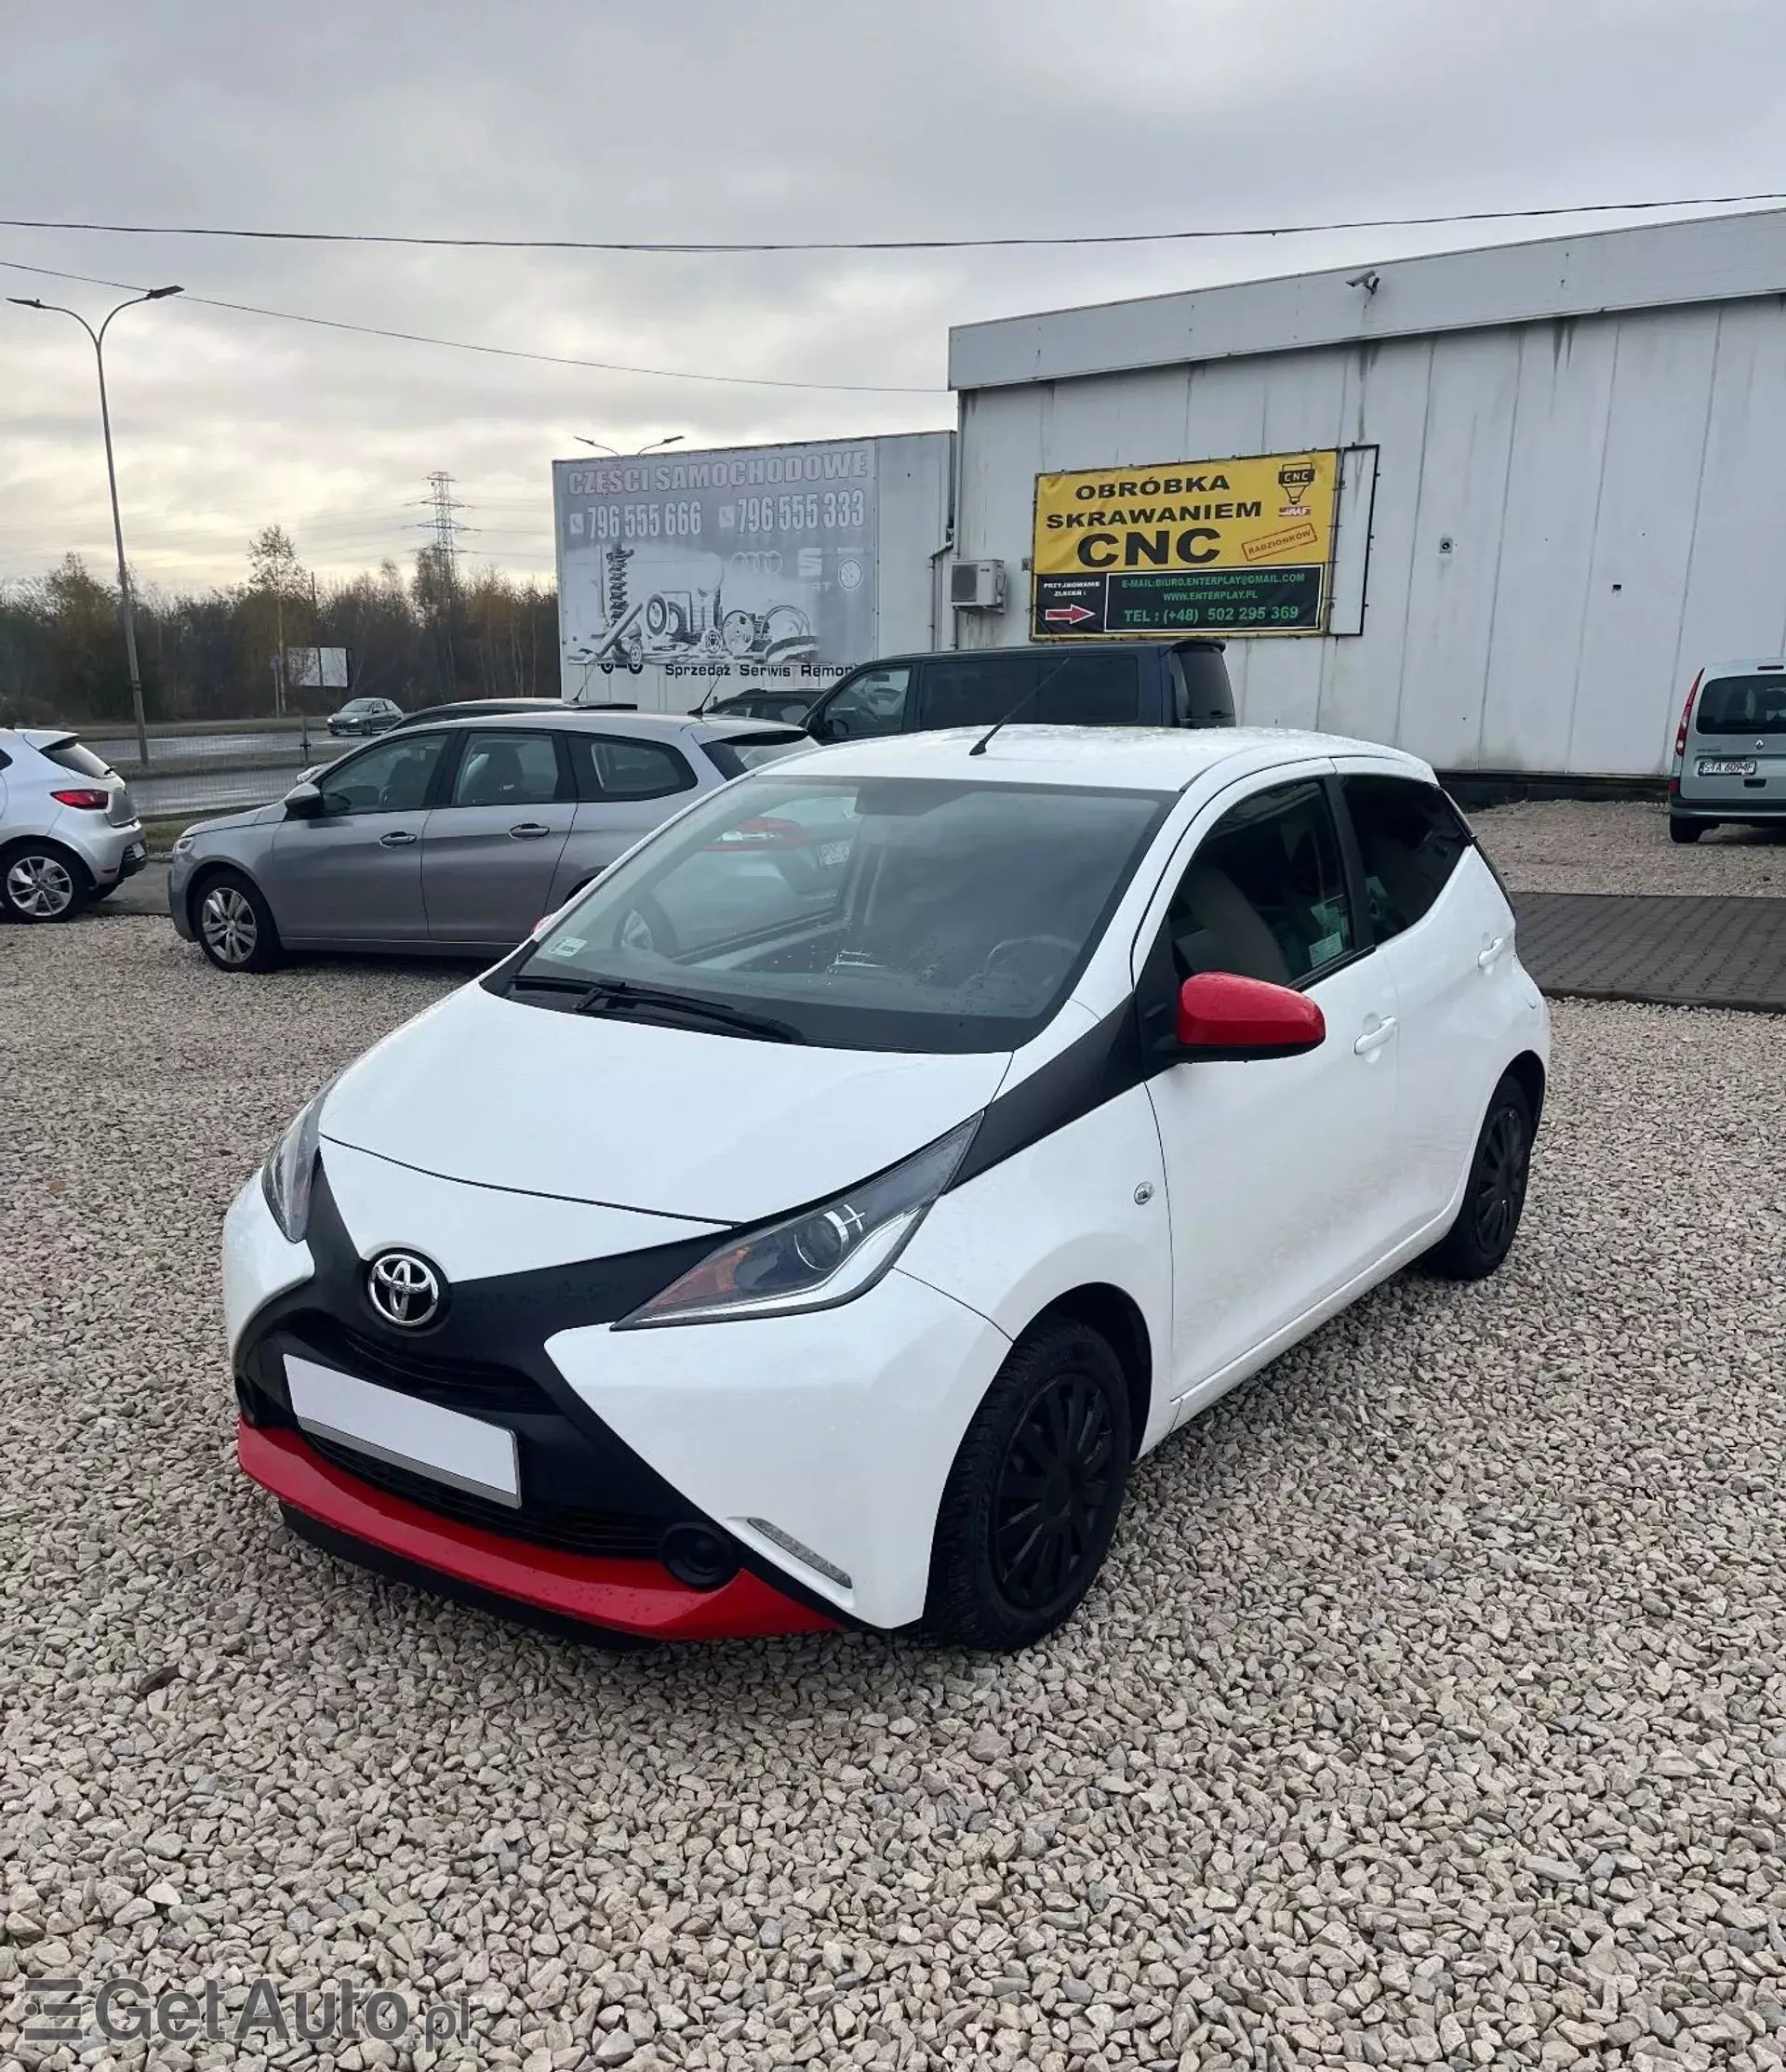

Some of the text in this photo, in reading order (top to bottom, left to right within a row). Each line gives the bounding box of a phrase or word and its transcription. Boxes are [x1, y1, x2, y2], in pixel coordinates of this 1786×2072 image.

[655, 450, 868, 492] SAMOCHODOWE
[1284, 471, 1309, 482] CNC
[1075, 474, 1231, 500] OBRÓBKA
[588, 500, 701, 539] 796 555 666
[738, 488, 864, 534] 796 555 333
[1046, 501, 1262, 529] SKRAWANIEM
[1077, 527, 1221, 568] CNC
[1163, 590, 1259, 602] WWW.ENTERPLAY.PL
[1124, 610, 1151, 622] TEL
[1163, 608, 1199, 624] (+48)
[1206, 607, 1234, 621] 502
[1238, 606, 1266, 620] 295
[1271, 605, 1300, 619] 369
[665, 664, 731, 678] Sprzedaż
[740, 664, 791, 676] Serwis
